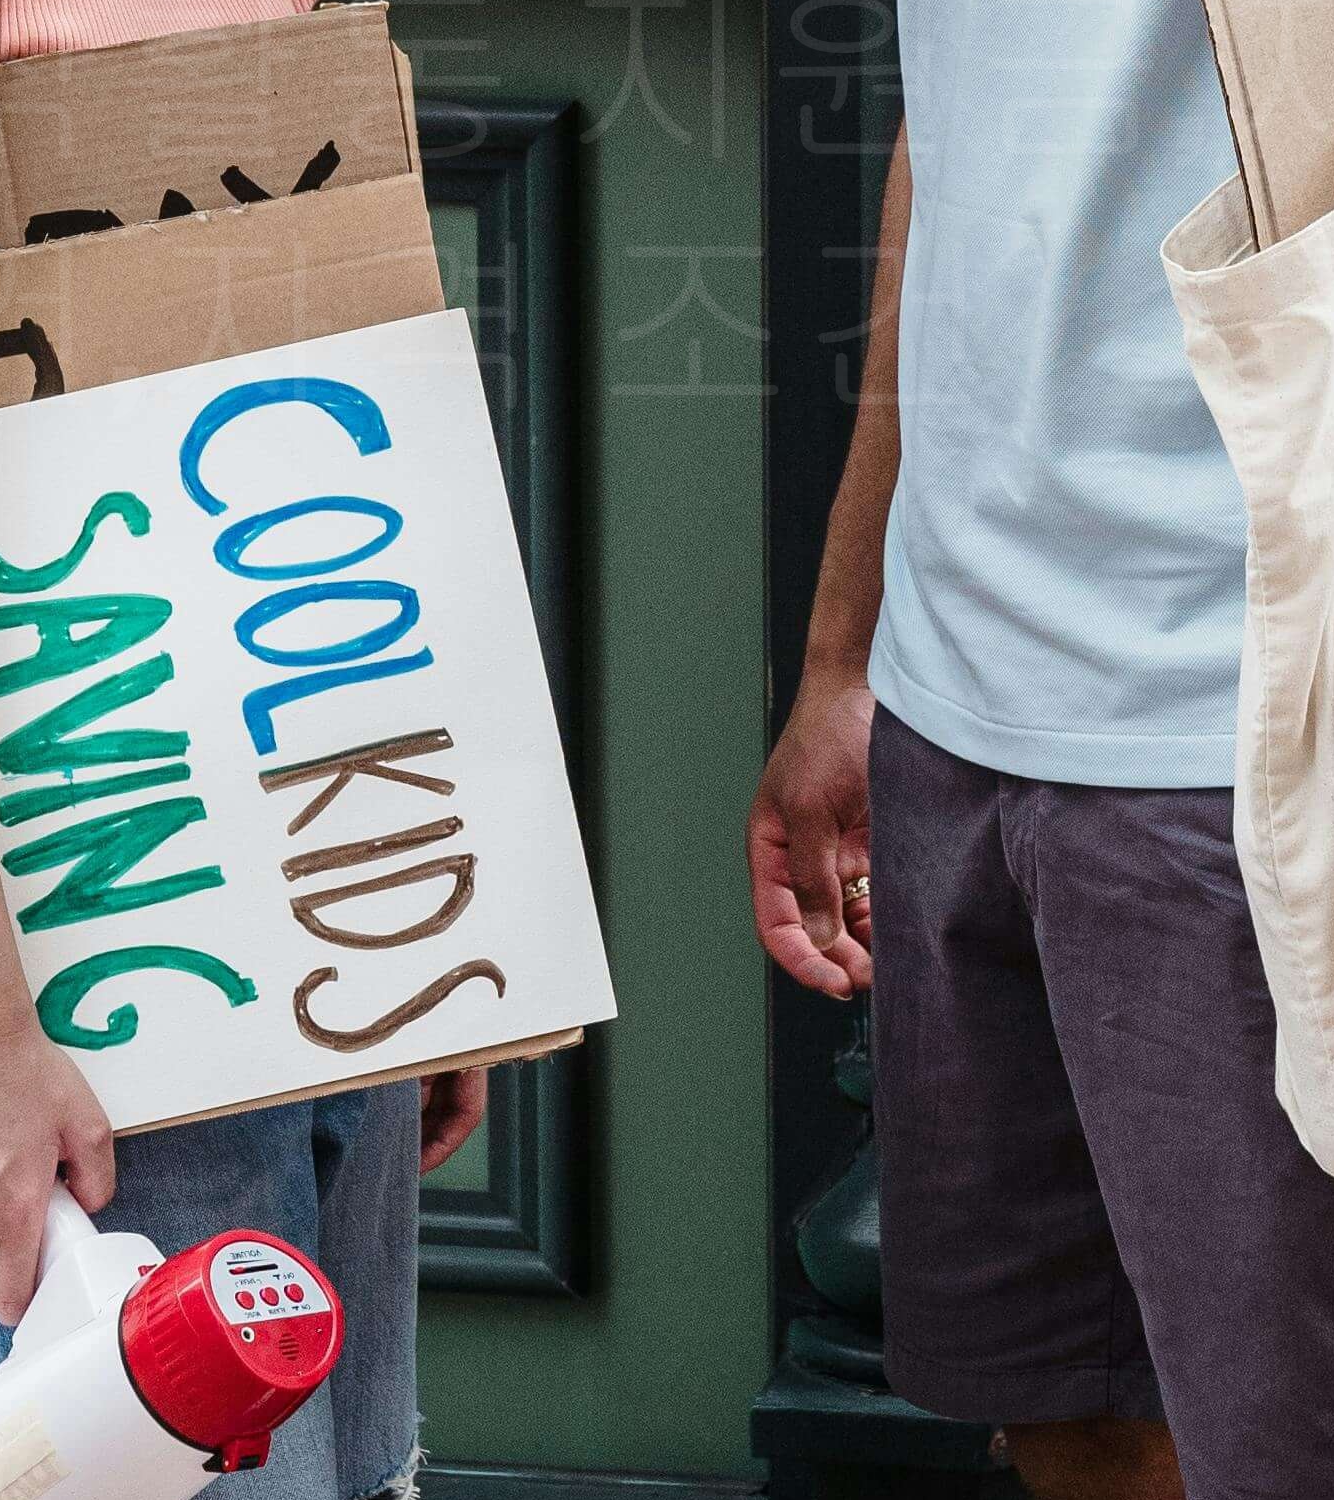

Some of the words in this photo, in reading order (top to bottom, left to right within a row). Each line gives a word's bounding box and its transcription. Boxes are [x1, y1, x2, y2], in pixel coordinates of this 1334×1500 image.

[179, 376, 434, 757] COOL
[258, 727, 507, 1054] KIDS
[229, 1249, 262, 1260] VOLUME
